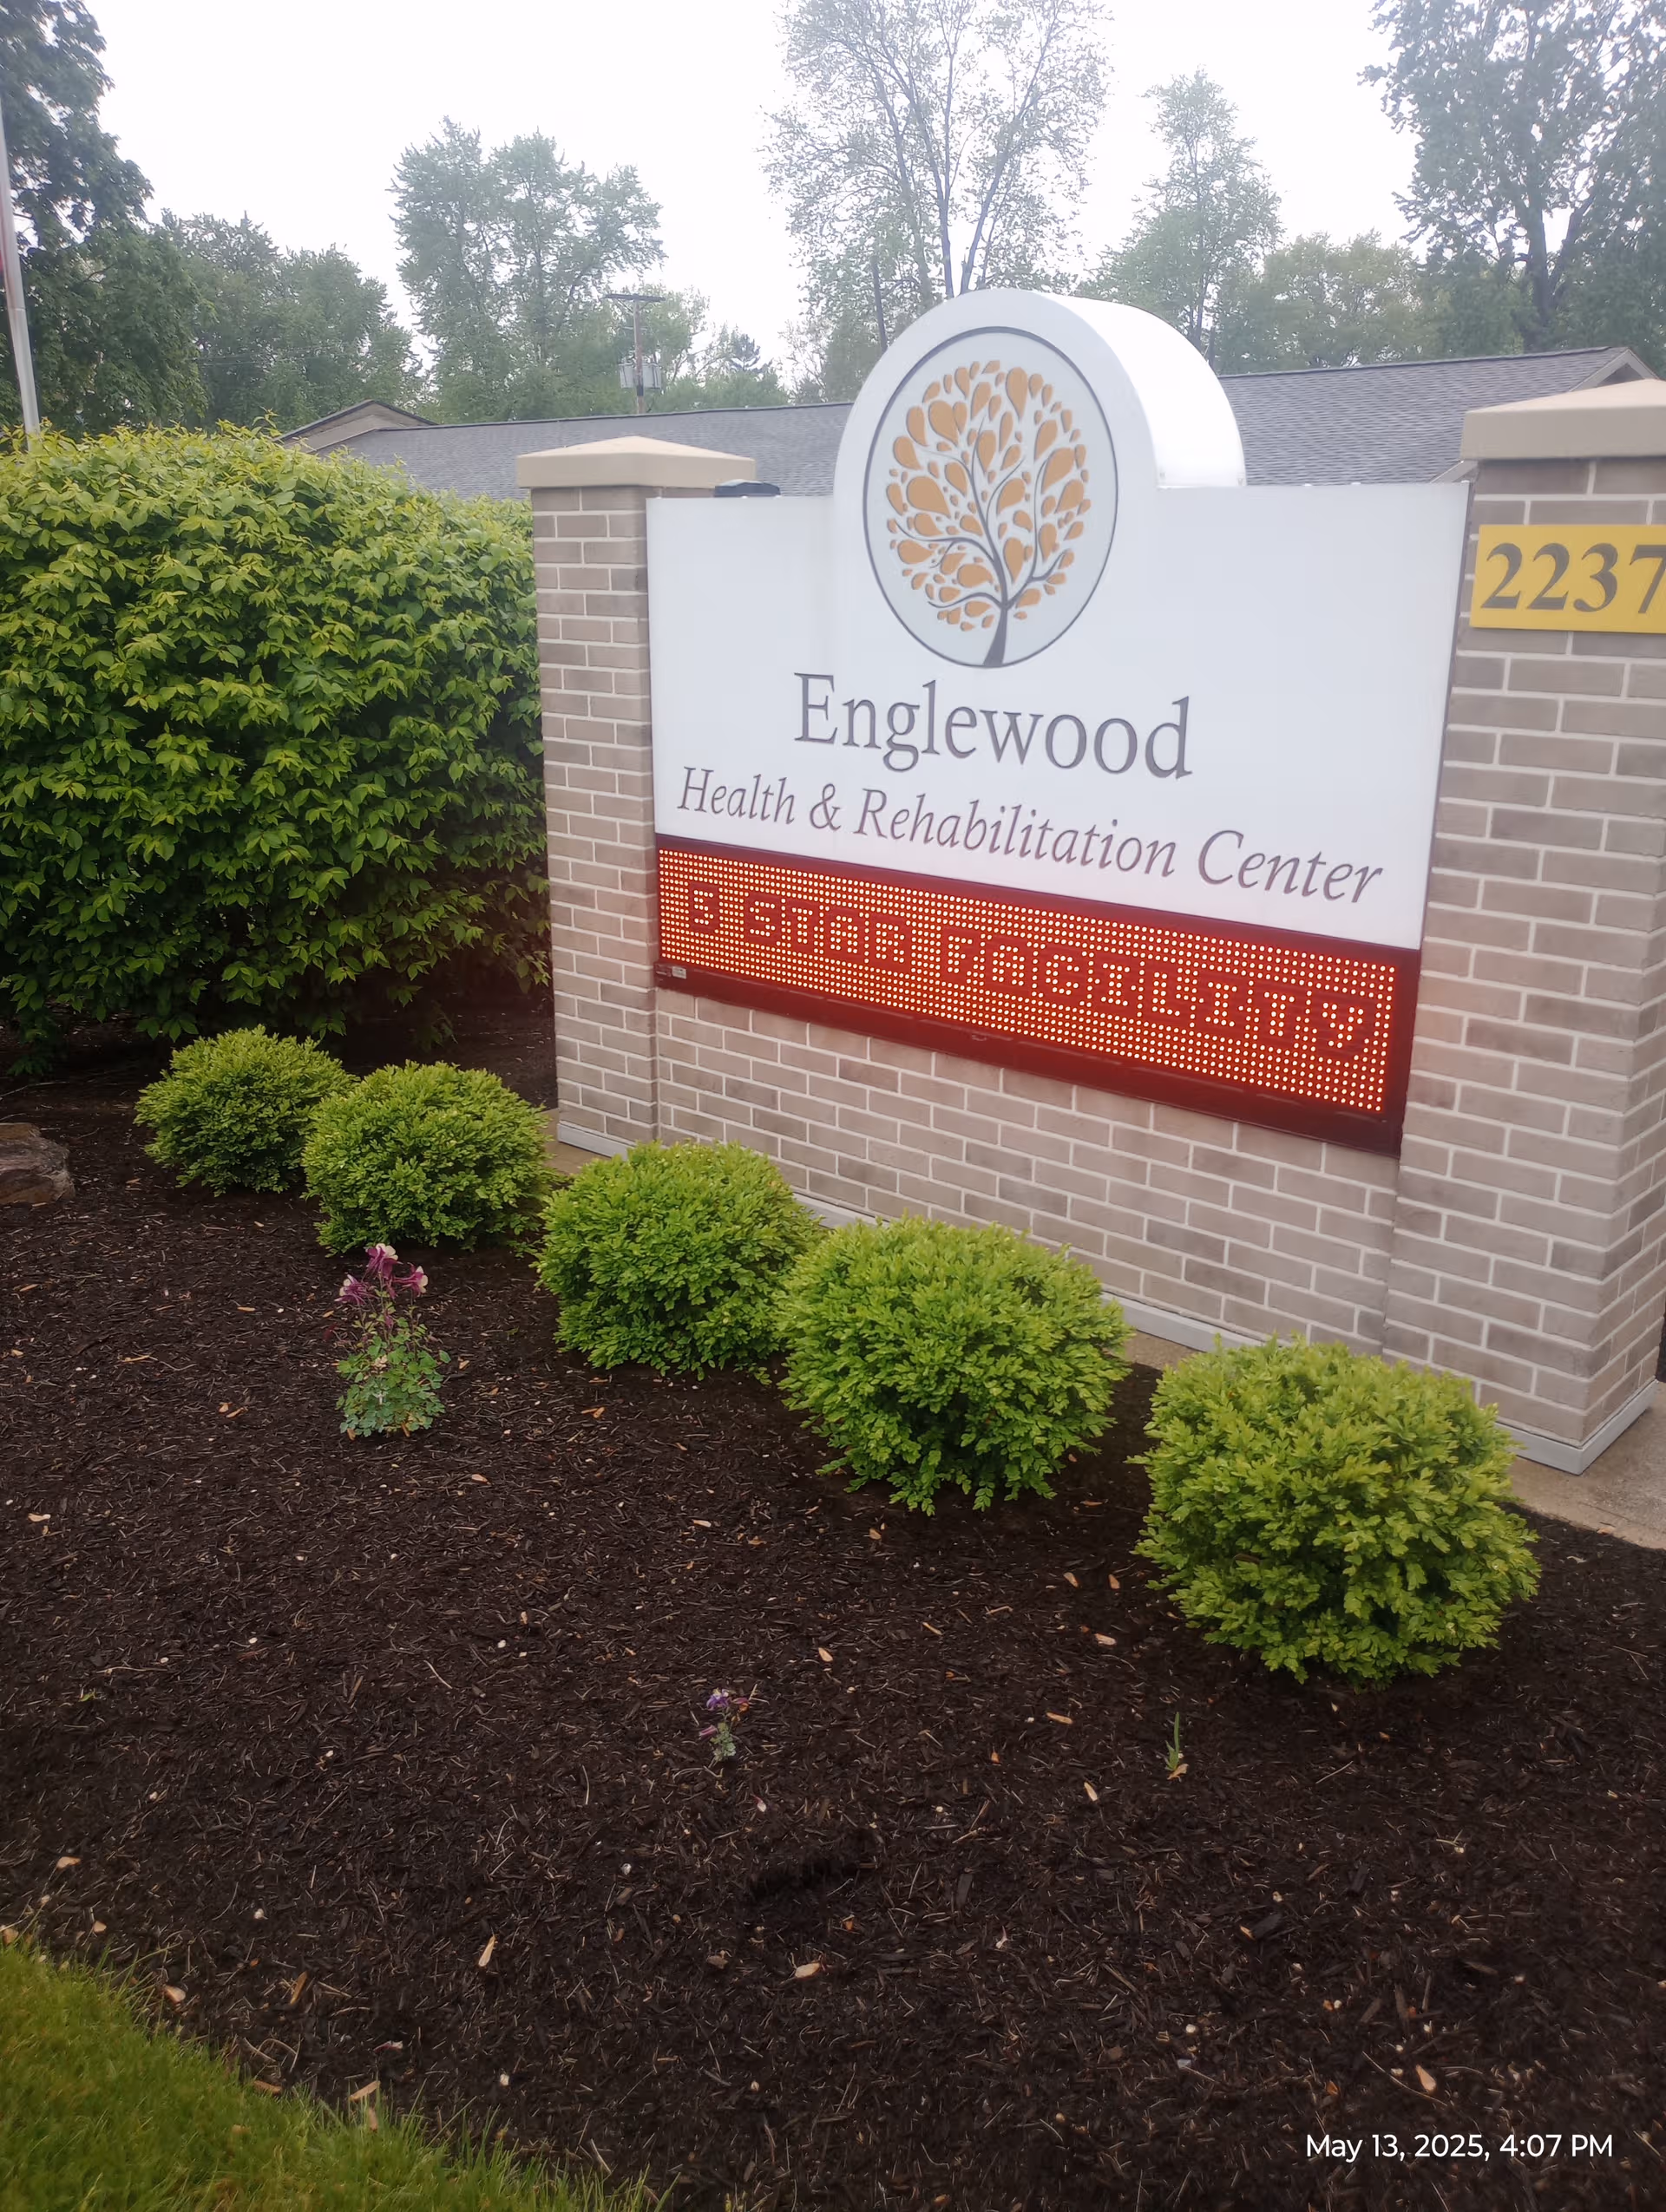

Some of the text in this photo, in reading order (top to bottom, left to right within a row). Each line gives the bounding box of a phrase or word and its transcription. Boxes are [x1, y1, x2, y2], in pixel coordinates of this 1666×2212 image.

[1480, 542, 1666, 613] 2237
[793, 671, 1193, 781] Englewood
[677, 765, 1384, 904] Health & Rehabilitation Center
[692, 887, 1368, 1050] 5 STAR FACILITY
